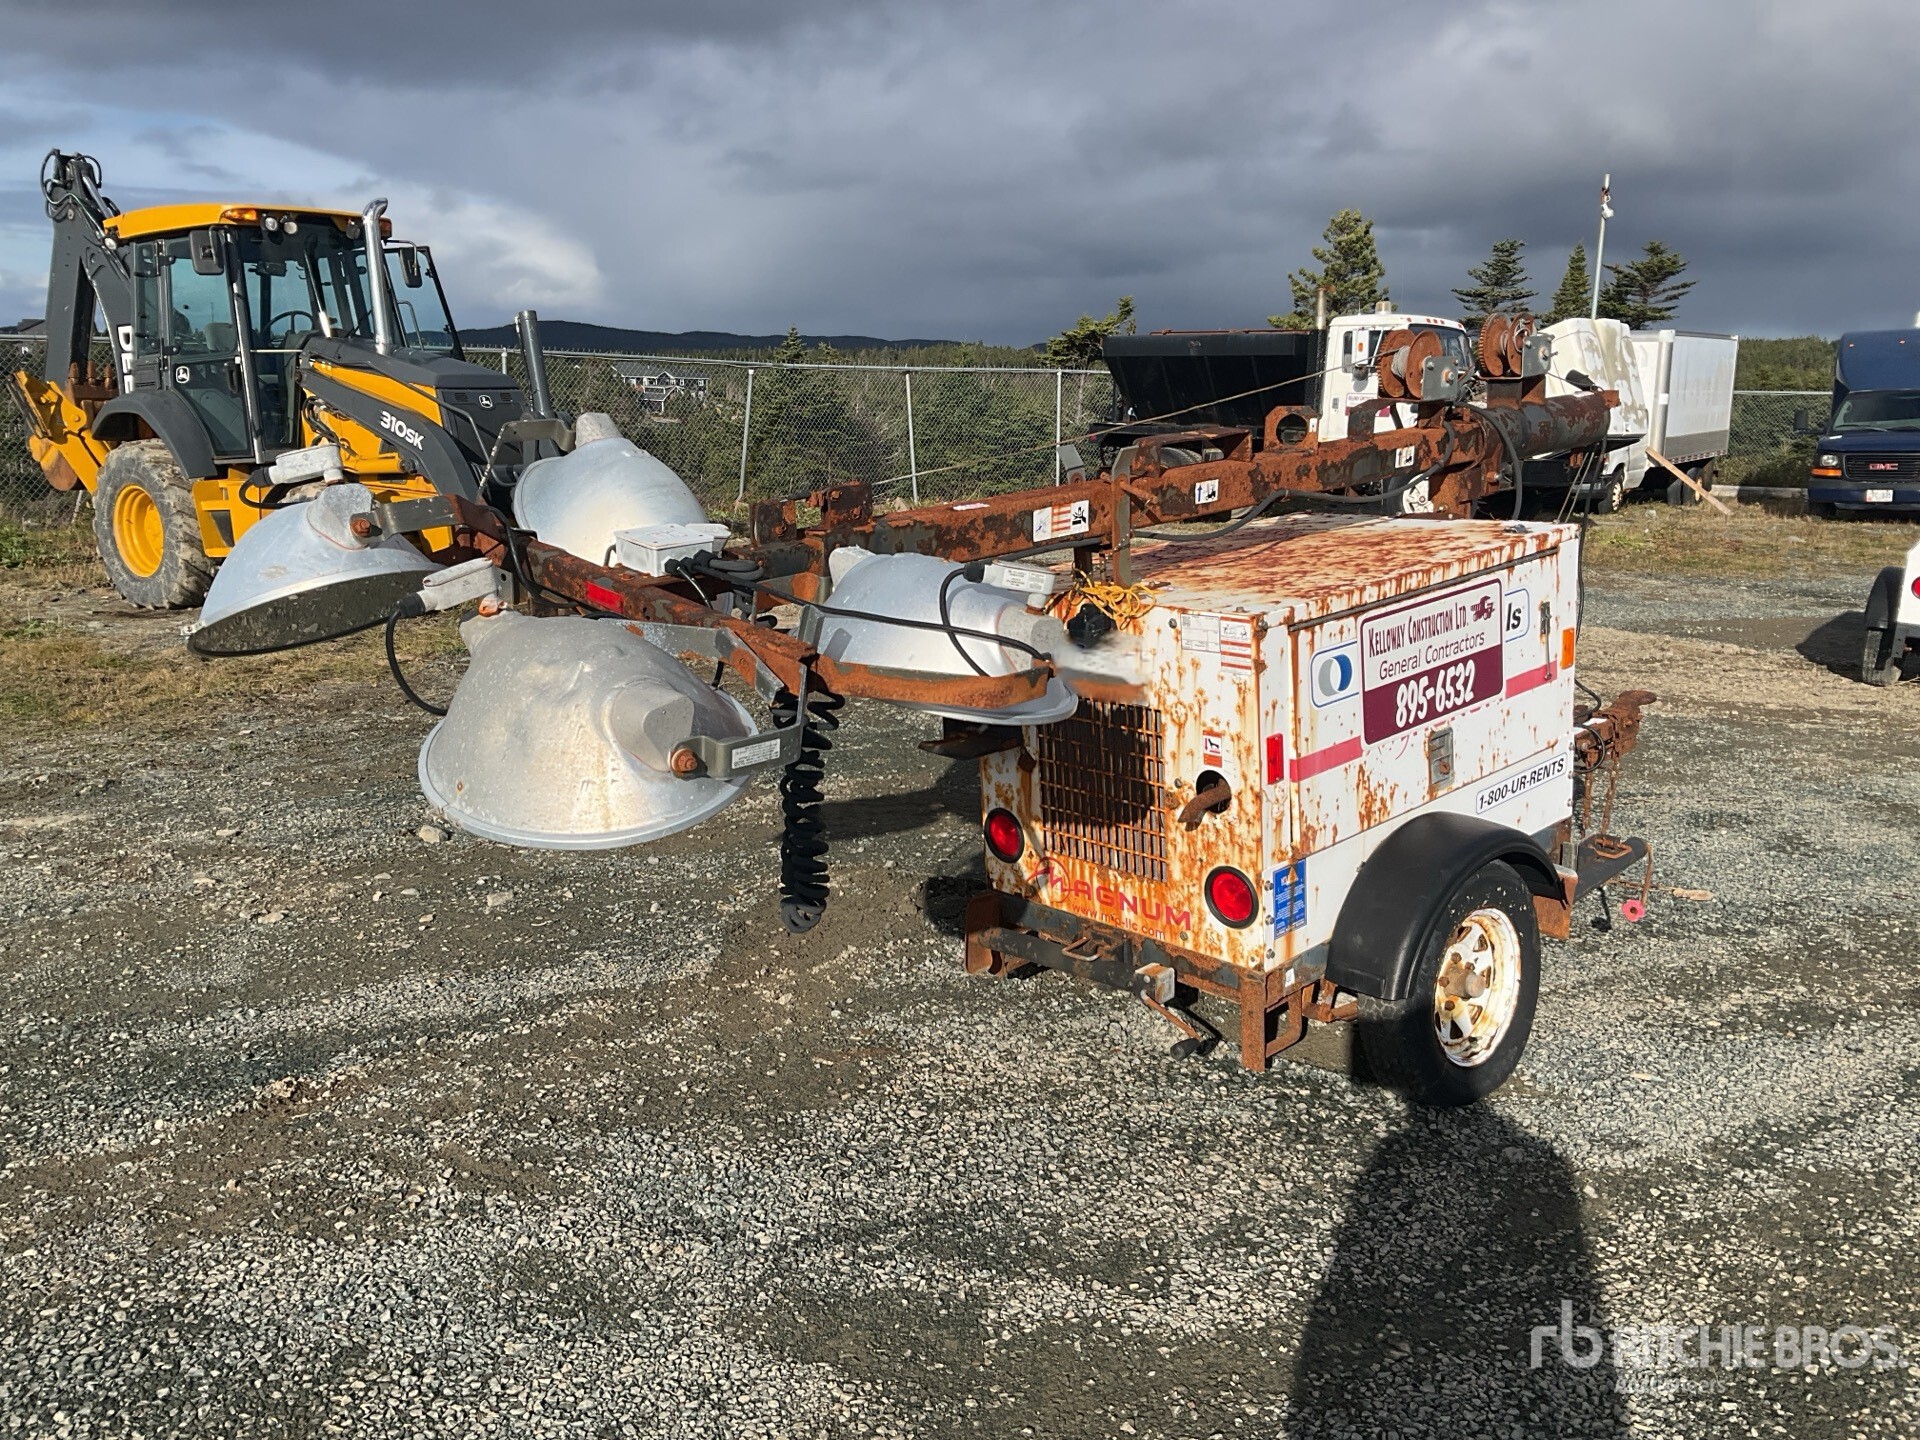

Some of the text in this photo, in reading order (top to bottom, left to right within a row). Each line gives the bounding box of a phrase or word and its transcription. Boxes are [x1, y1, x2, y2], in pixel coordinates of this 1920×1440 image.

[380, 410, 424, 451] 310SK
[1868, 462, 1899, 471] GMC
[1368, 602, 1469, 657] KELLOWAY CONSTRUCTION LTD.
[1379, 631, 1485, 681] General Contractors
[1395, 659, 1475, 729] 895-6532
[1479, 757, 1564, 810] 1-800-UR-RENTS
